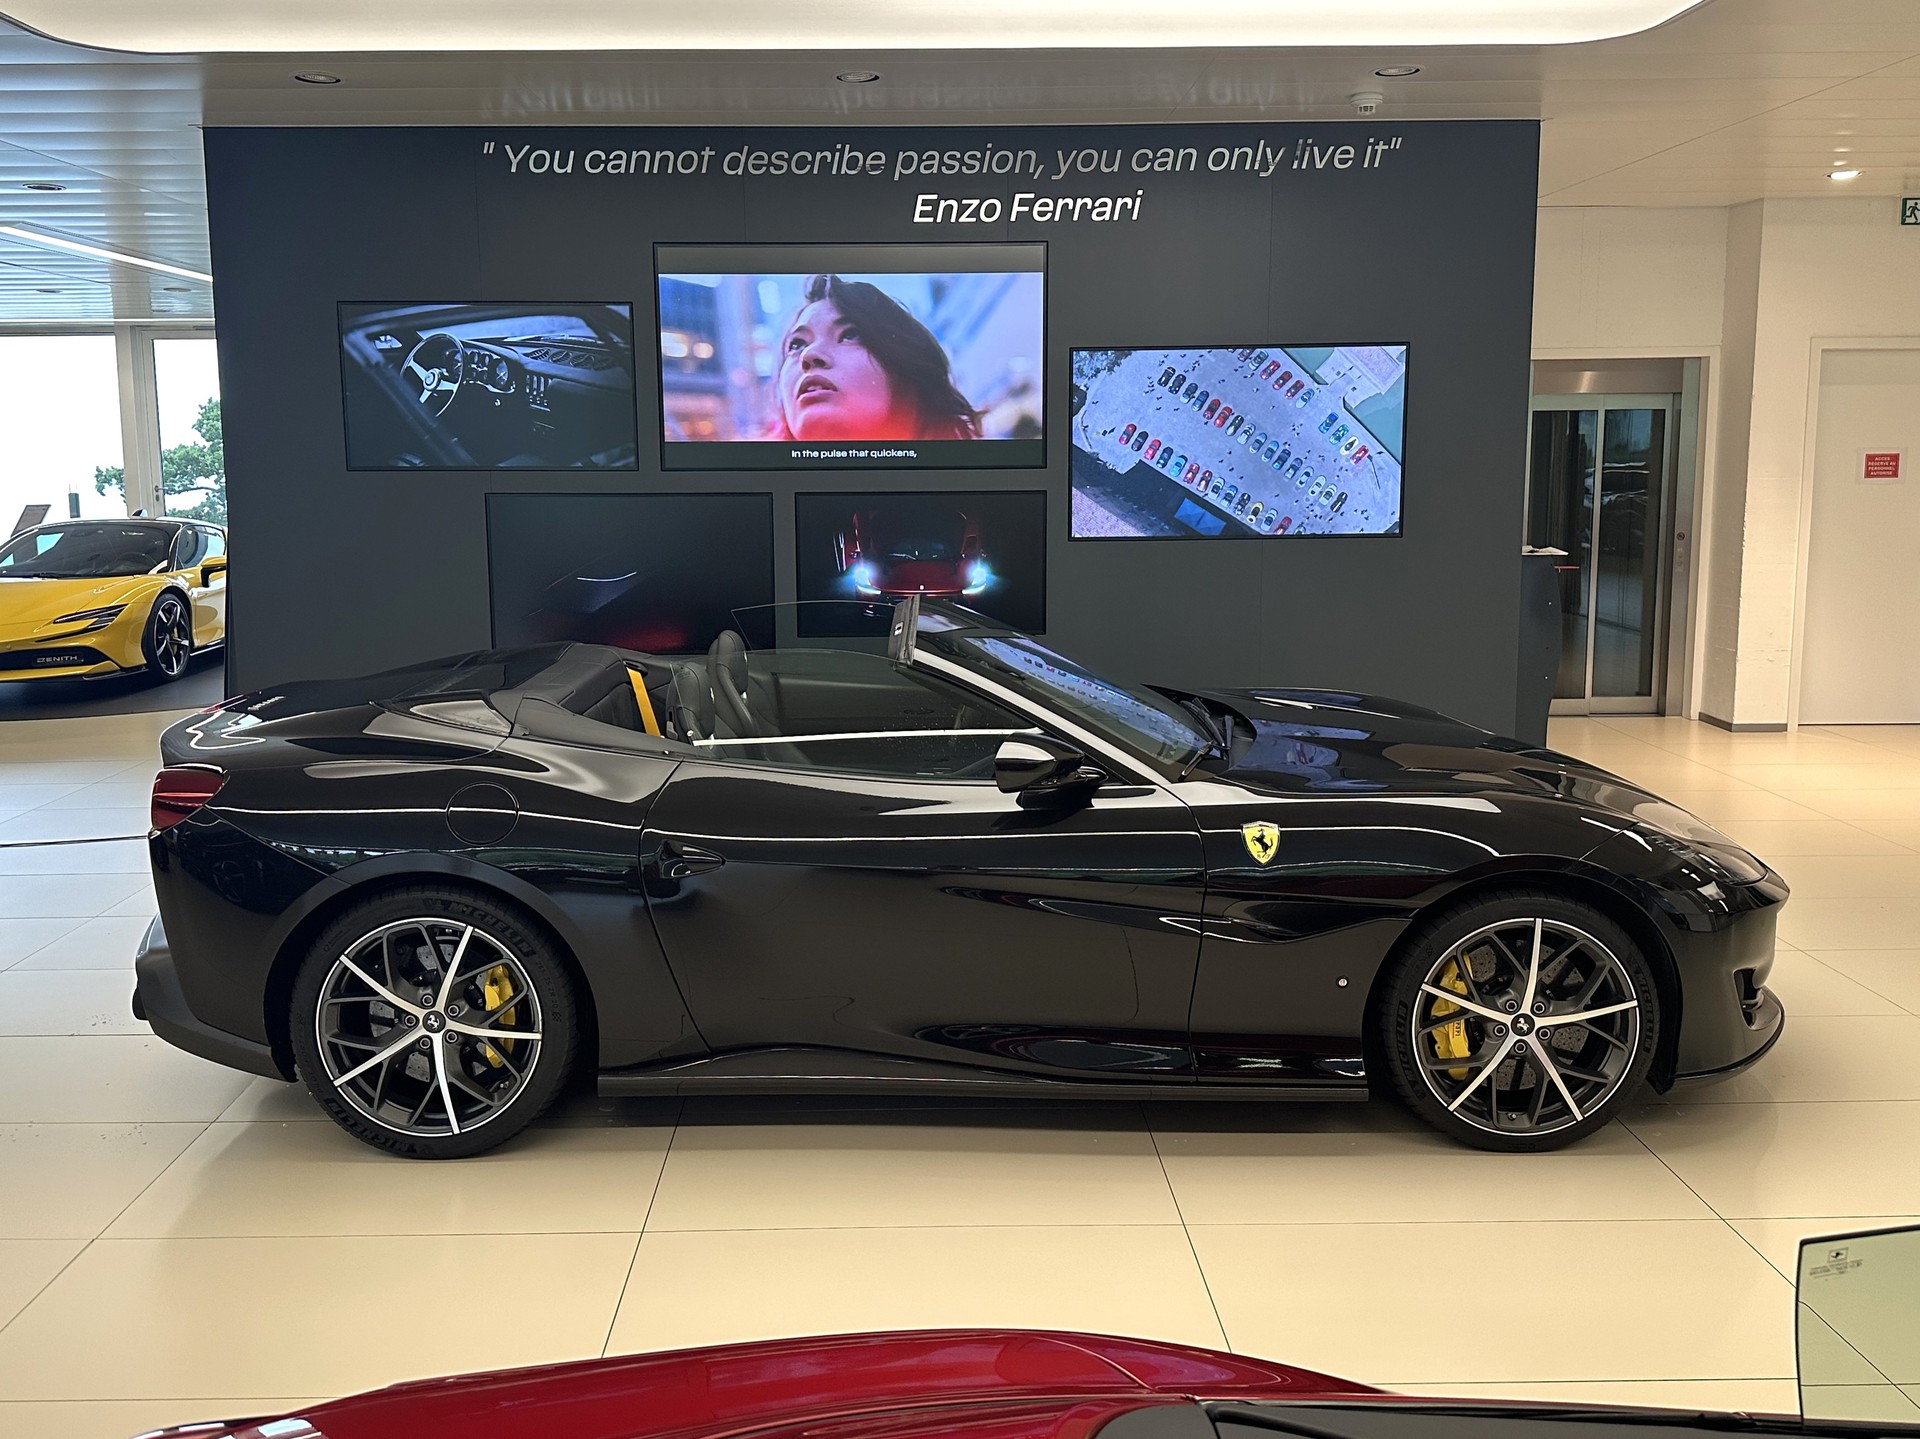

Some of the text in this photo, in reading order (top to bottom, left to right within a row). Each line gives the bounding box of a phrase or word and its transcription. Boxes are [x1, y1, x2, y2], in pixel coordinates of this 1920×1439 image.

[584, 146, 716, 174] cannot
[722, 143, 886, 176] describe
[893, 142, 1045, 181] passion,
[1050, 149, 1122, 180] you
[1131, 147, 1198, 173] can
[1207, 139, 1286, 177] only
[1291, 138, 1355, 170] live
[1362, 137, 1403, 169] it"
[913, 189, 1144, 223] Enzo Ferrari
[791, 448, 917, 459] In the pulse that quickens,
[36, 655, 78, 663] ZENITH
[447, 902, 532, 956] MICHELIN
[327, 1101, 410, 1153] MICHELIN
